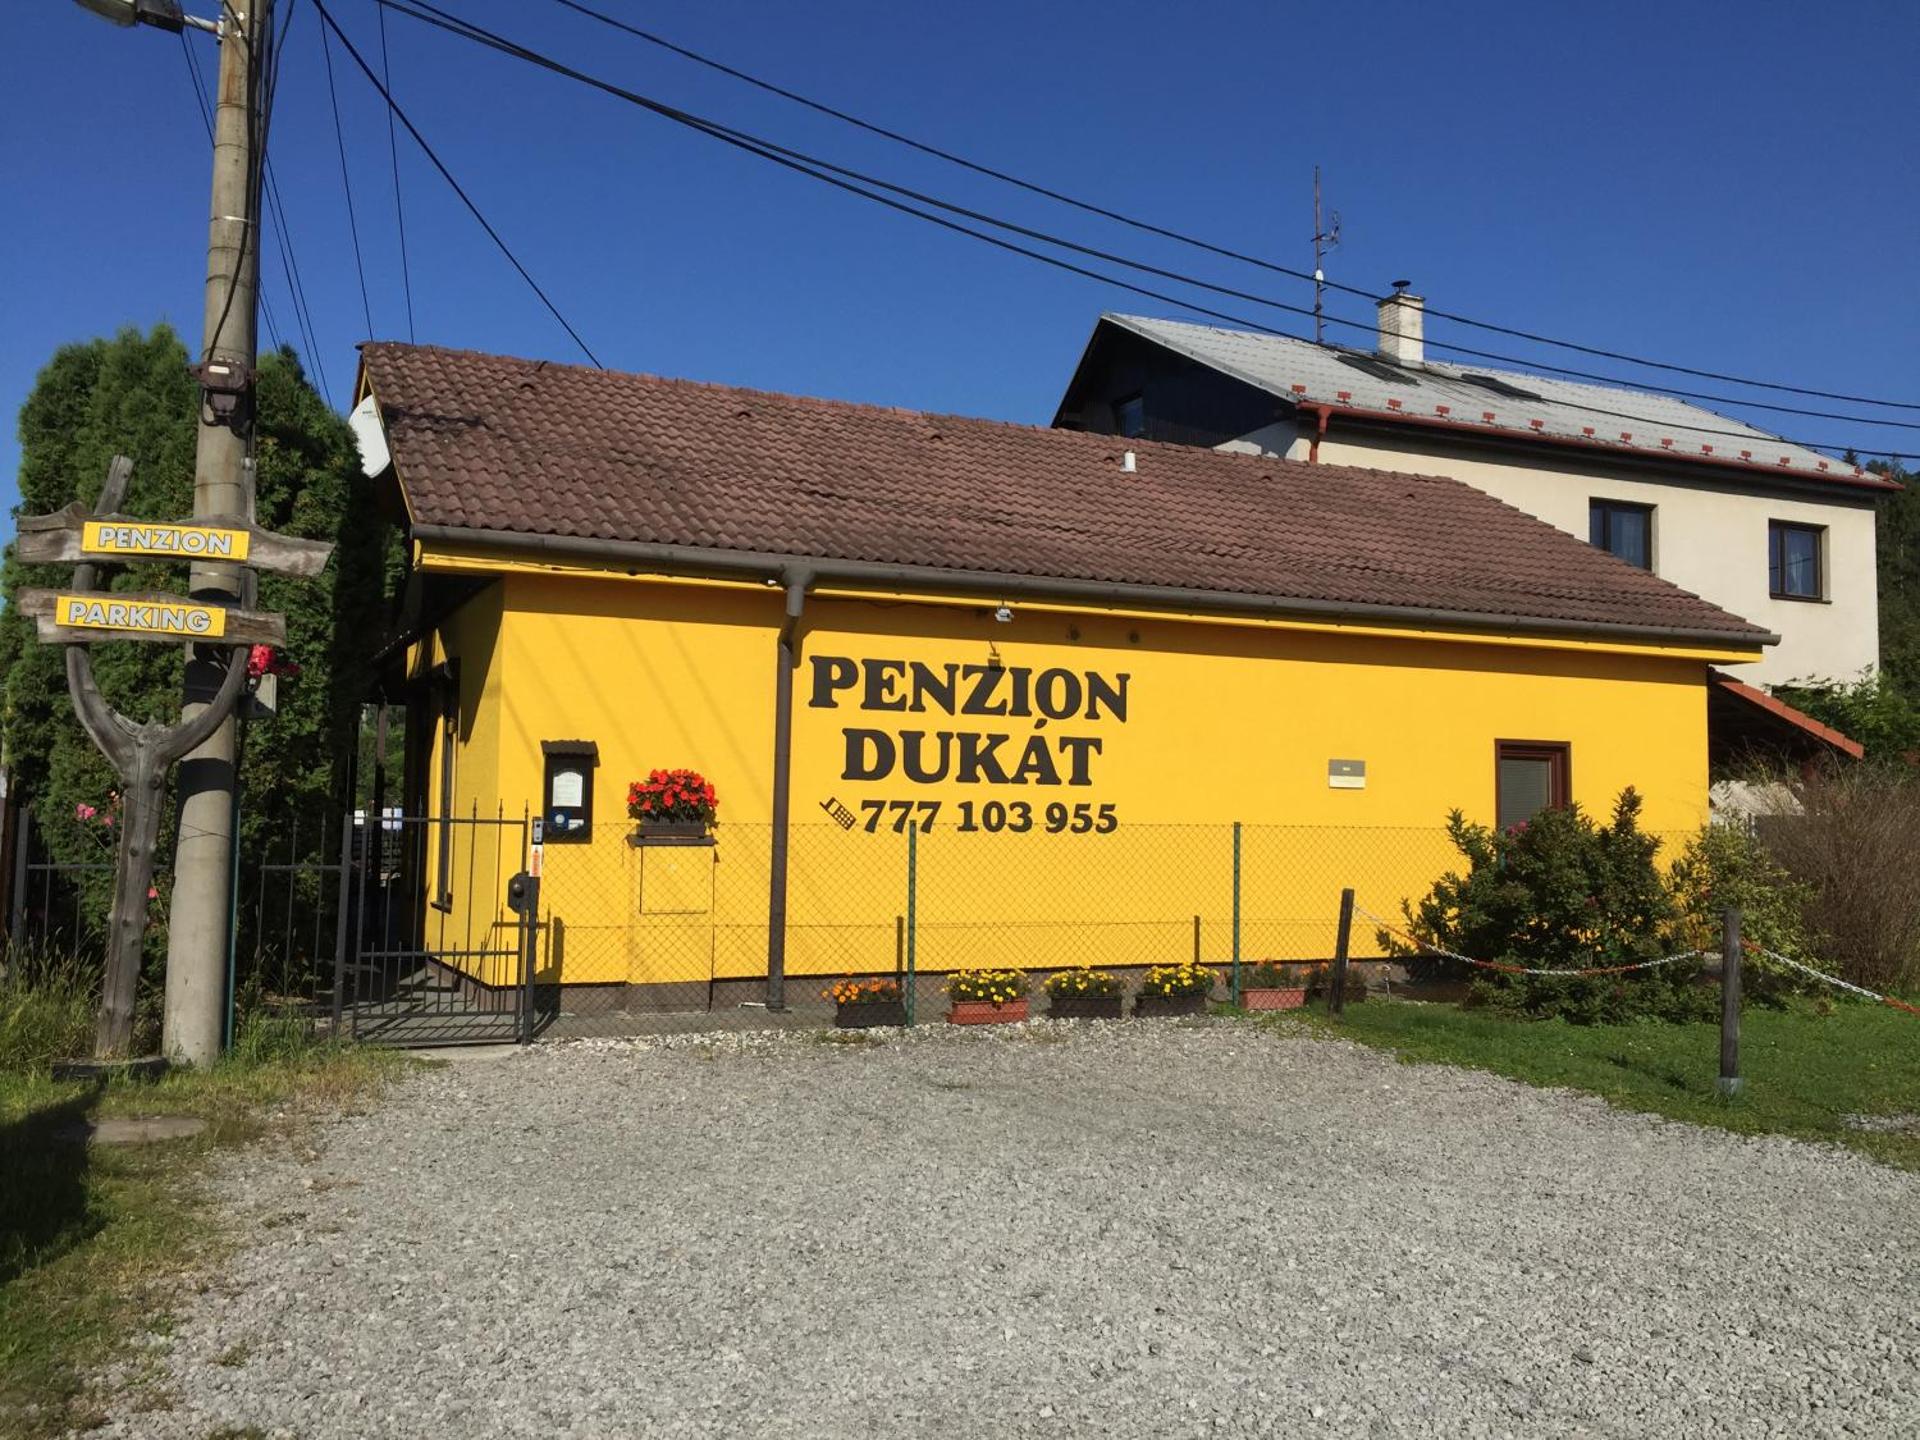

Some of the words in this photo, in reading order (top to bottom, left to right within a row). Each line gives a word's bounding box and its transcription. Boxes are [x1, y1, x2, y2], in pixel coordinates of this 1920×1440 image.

[98, 527, 232, 555] PENZION
[68, 601, 212, 632] PARKING
[808, 655, 1131, 723] PENZION
[840, 718, 1103, 786] DUKÁT
[861, 799, 942, 834] 777
[957, 800, 1033, 833] 103
[1045, 802, 1118, 834] 955
